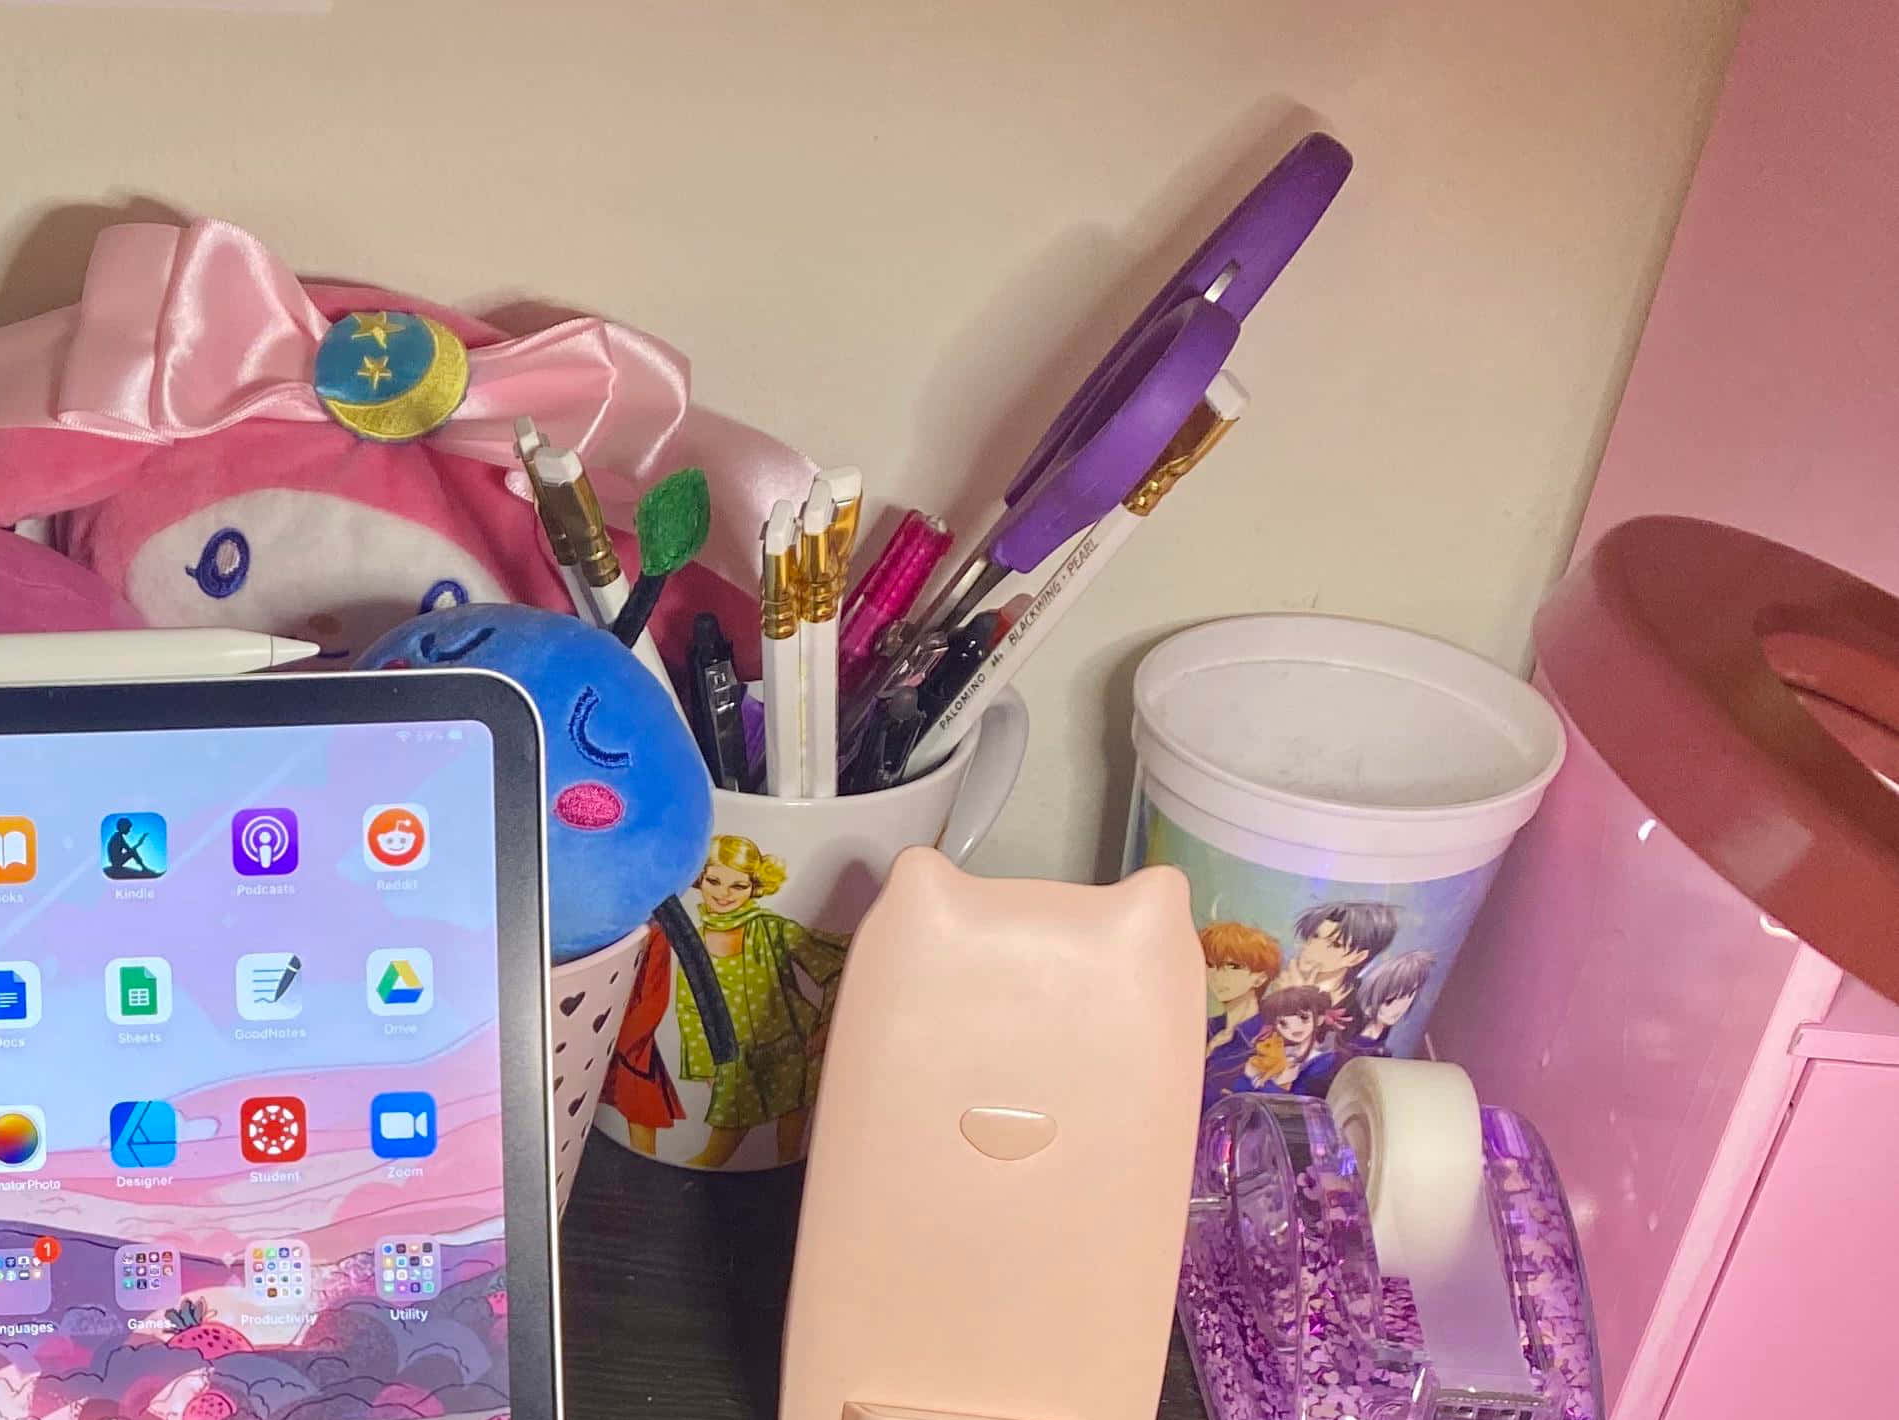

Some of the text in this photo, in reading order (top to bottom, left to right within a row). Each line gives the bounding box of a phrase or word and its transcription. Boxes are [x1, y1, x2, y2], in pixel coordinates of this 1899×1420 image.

[939, 538, 1099, 730] PALOMINO BLACKWING PEARL
[116, 888, 154, 899] Kindle
[237, 885, 294, 896] Podcasts
[235, 1028, 306, 1040] GoodNotes
[384, 1024, 417, 1034] Drive
[118, 1032, 161, 1043] Sheets
[250, 1171, 299, 1182] Student
[388, 1166, 423, 1178] Zoom
[117, 1176, 173, 1188] Designer
[242, 1312, 316, 1329] Productivity
[390, 1308, 428, 1322] Utility
[128, 1317, 172, 1330] Games
